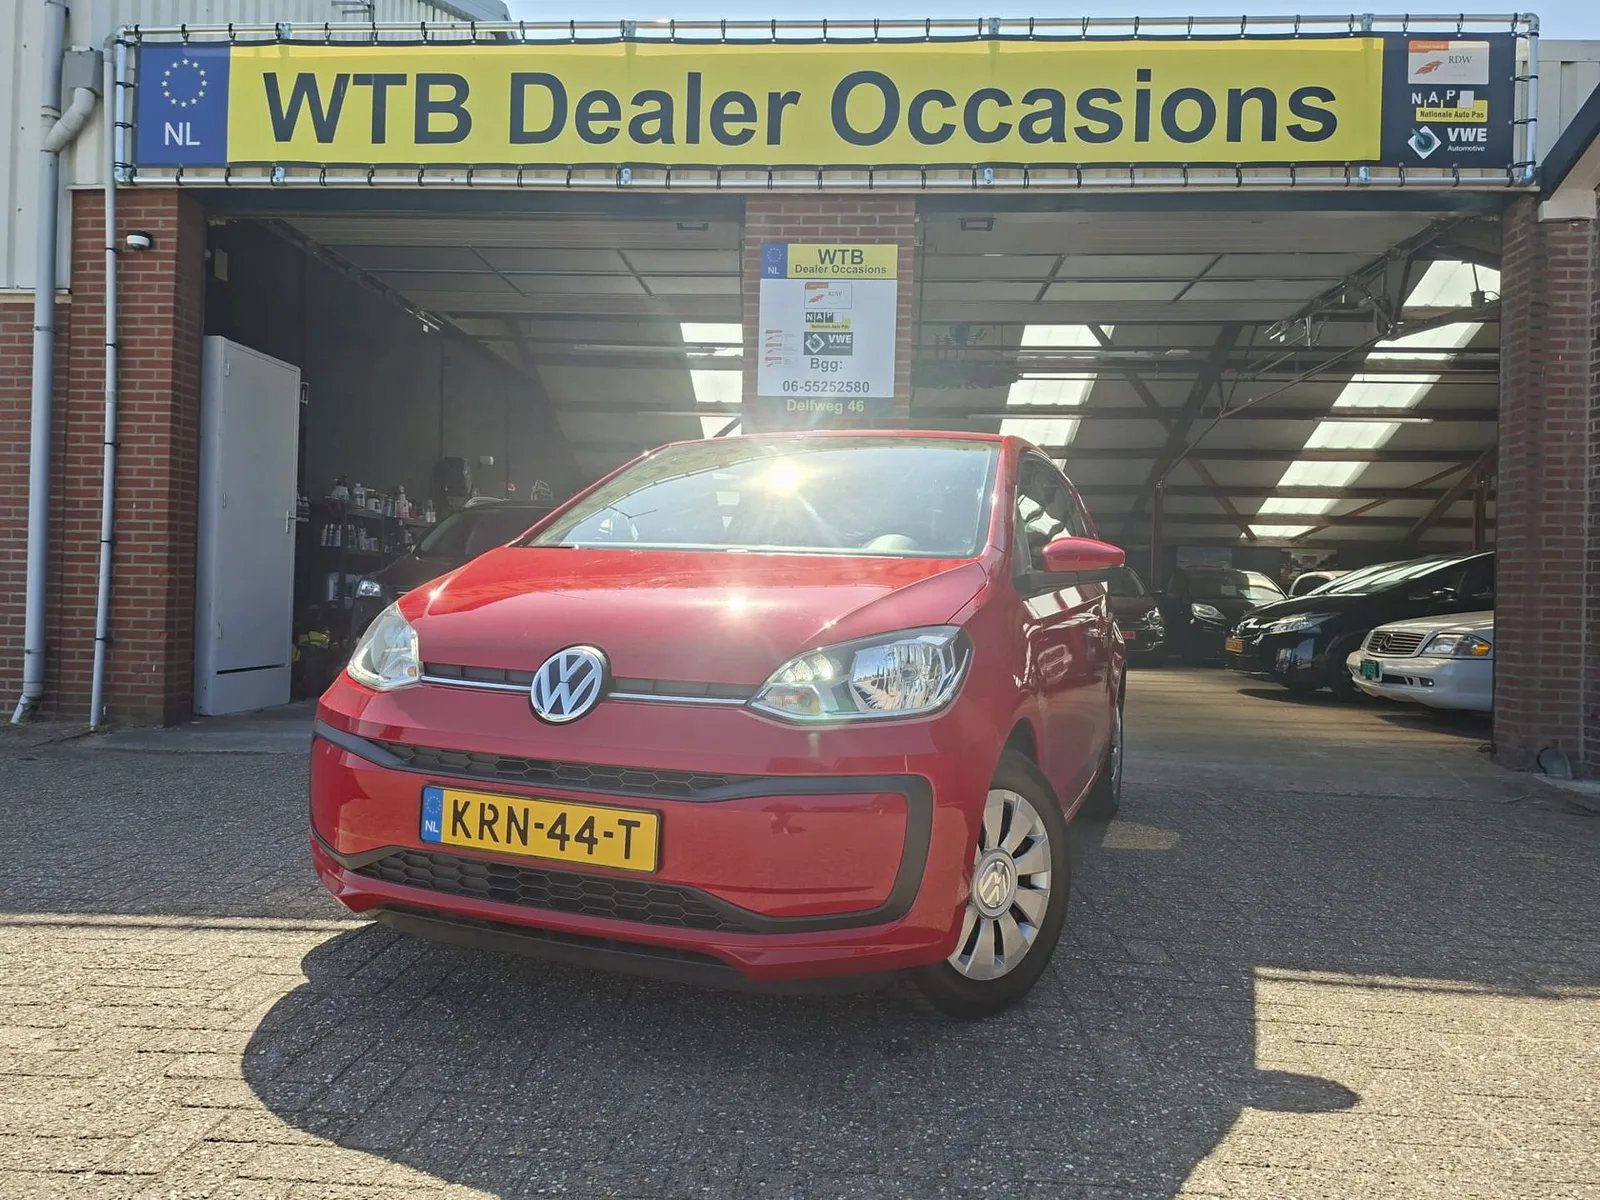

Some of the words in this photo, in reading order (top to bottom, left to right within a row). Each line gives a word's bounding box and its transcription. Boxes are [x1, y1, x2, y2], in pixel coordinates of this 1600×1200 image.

[1448, 55, 1472, 64] RDW
[262, 71, 473, 146] WTB
[510, 71, 800, 147] Dealer
[829, 68, 1339, 146] Occasions
[1420, 110, 1452, 118] Nationale
[164, 121, 200, 146] NL
[1447, 127, 1487, 142] VWE
[818, 249, 864, 265] WTB
[767, 266, 780, 275] NL
[795, 264, 827, 274] Dealer
[831, 264, 887, 274] Occasions
[828, 334, 852, 344] VWE
[810, 358, 843, 372] Bgg:
[782, 380, 870, 393] 06-55252580
[786, 400, 843, 414] Delfweg
[847, 400, 864, 412] 46
[425, 819, 439, 833] NL
[451, 799, 641, 860] KRN-44-T
